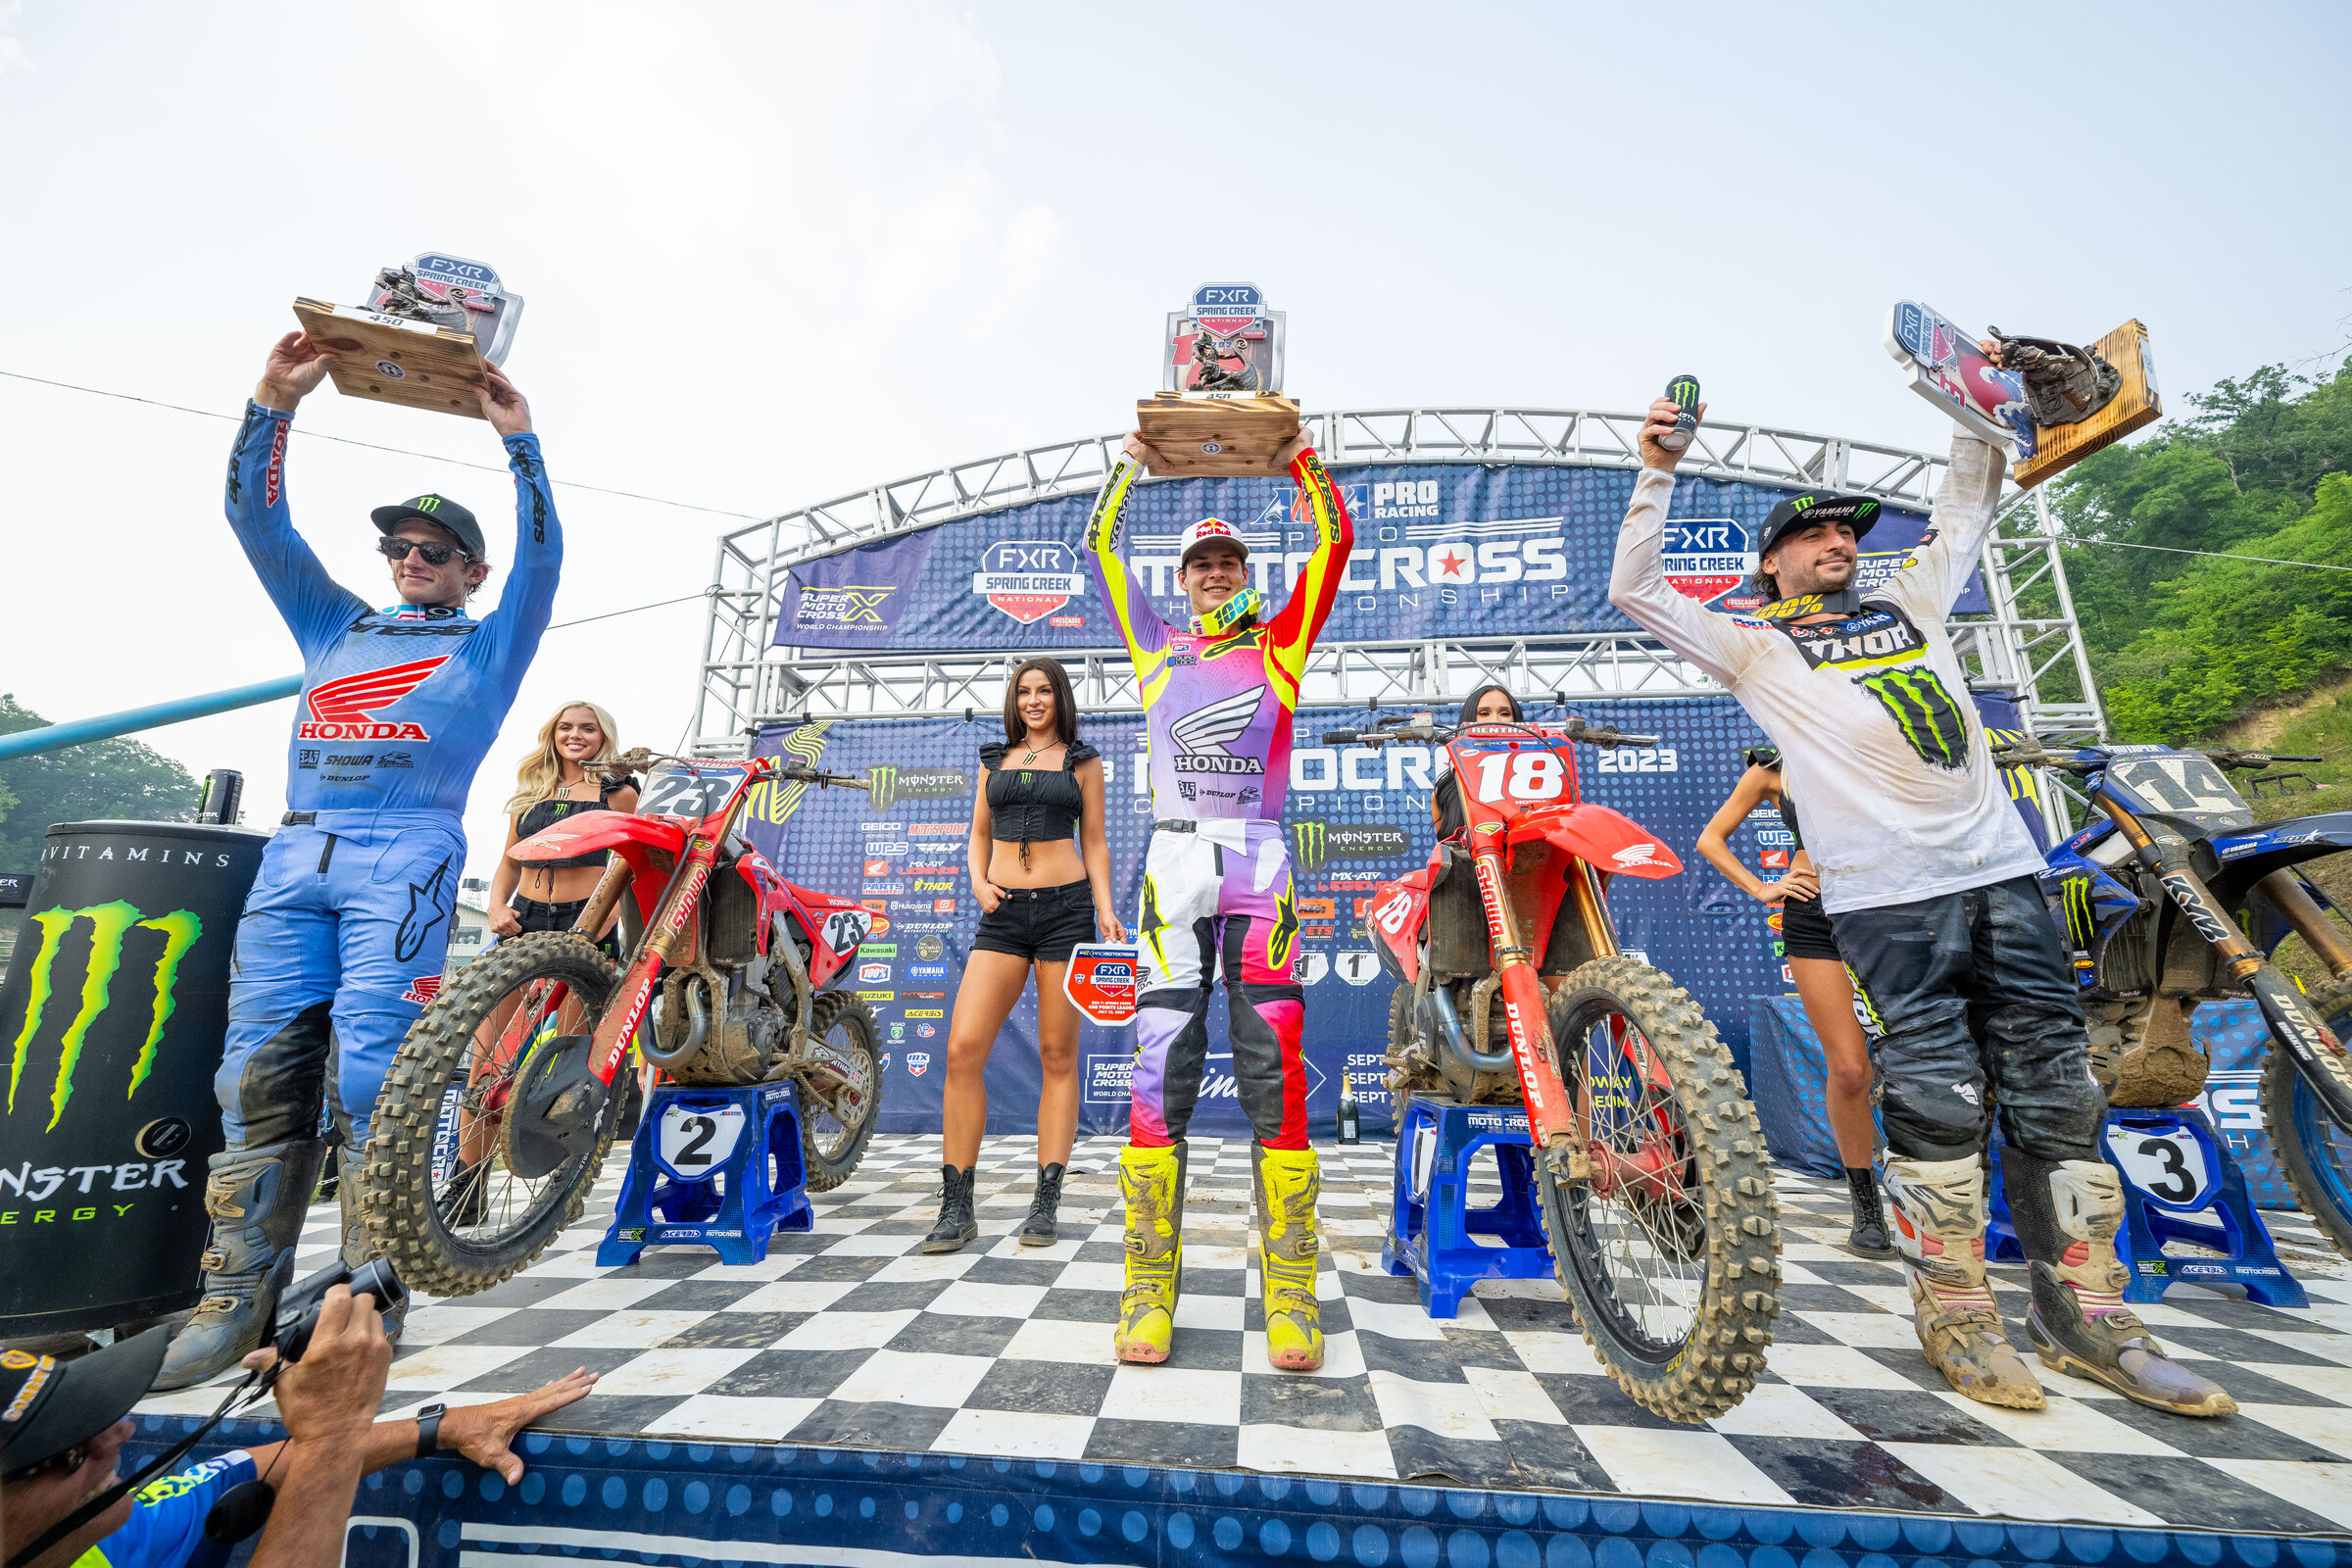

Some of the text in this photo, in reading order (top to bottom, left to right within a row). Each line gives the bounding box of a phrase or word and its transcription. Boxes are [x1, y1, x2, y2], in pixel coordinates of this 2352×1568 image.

[430, 258, 484, 278] FXR
[416, 270, 489, 291] SPRING CREEK
[1205, 290, 1250, 303] FXR
[368, 315, 405, 326] 450
[1197, 307, 1256, 317] SPRING CREEK
[1904, 308, 1919, 344] FXR
[267, 419, 290, 508] HONDA
[1306, 455, 1343, 544] alpinestars
[1374, 480, 1439, 507] PRO
[1374, 505, 1439, 518] RACING
[1815, 506, 1855, 515] YAMAHA
[1197, 527, 1232, 539] Red Bull
[1663, 527, 1729, 549] FXR
[1000, 549, 1060, 569] FXR
[1699, 557, 1744, 570] CREEK
[986, 577, 1071, 591] SPRING CREEK
[800, 593, 850, 603] SUPER
[801, 602, 847, 612] MOTO
[1750, 594, 1825, 619] 100%
[796, 611, 847, 619] CROSS
[1801, 621, 1916, 661] THOR
[298, 722, 430, 742] HONDA
[323, 755, 374, 766] SHOWA
[1174, 756, 1264, 775] HONDA
[1597, 749, 1678, 772] 2023
[899, 774, 963, 786] MONSTER
[1476, 752, 1566, 804] 18
[637, 775, 732, 817] 23
[1747, 809, 1782, 818] GEIC
[1328, 830, 1403, 844] MONSTER
[50, 846, 231, 868] VITAMINS
[866, 842, 908, 856] WPS
[913, 843, 964, 852] FLY
[2230, 842, 2258, 853] YAMAHA
[1617, 858, 1675, 868] HONDA
[923, 882, 954, 891] THOR
[671, 867, 708, 934] SHOWA
[1475, 864, 1506, 939] SHOWA
[2160, 874, 2231, 943] KYB
[1374, 891, 1412, 934] 18
[830, 911, 865, 954] 23
[1306, 926, 1334, 936] ETS
[863, 968, 887, 979] 100%
[1101, 965, 1126, 975] FXR
[1348, 955, 1360, 978] 1
[608, 978, 652, 1069] DUNLOP
[2277, 1021, 2314, 1061] BRAKING
[1348, 1054, 1385, 1066] SEPT
[1505, 1002, 1544, 1108] DUNLOP
[1348, 1073, 1385, 1085] SEPT
[673, 1116, 716, 1165] 2
[2137, 1138, 2197, 1202] 3
[0, 1159, 190, 1202] NSTER
[0, 1203, 135, 1225] ERGY
[2180, 1265, 2228, 1274] ACERBIS
